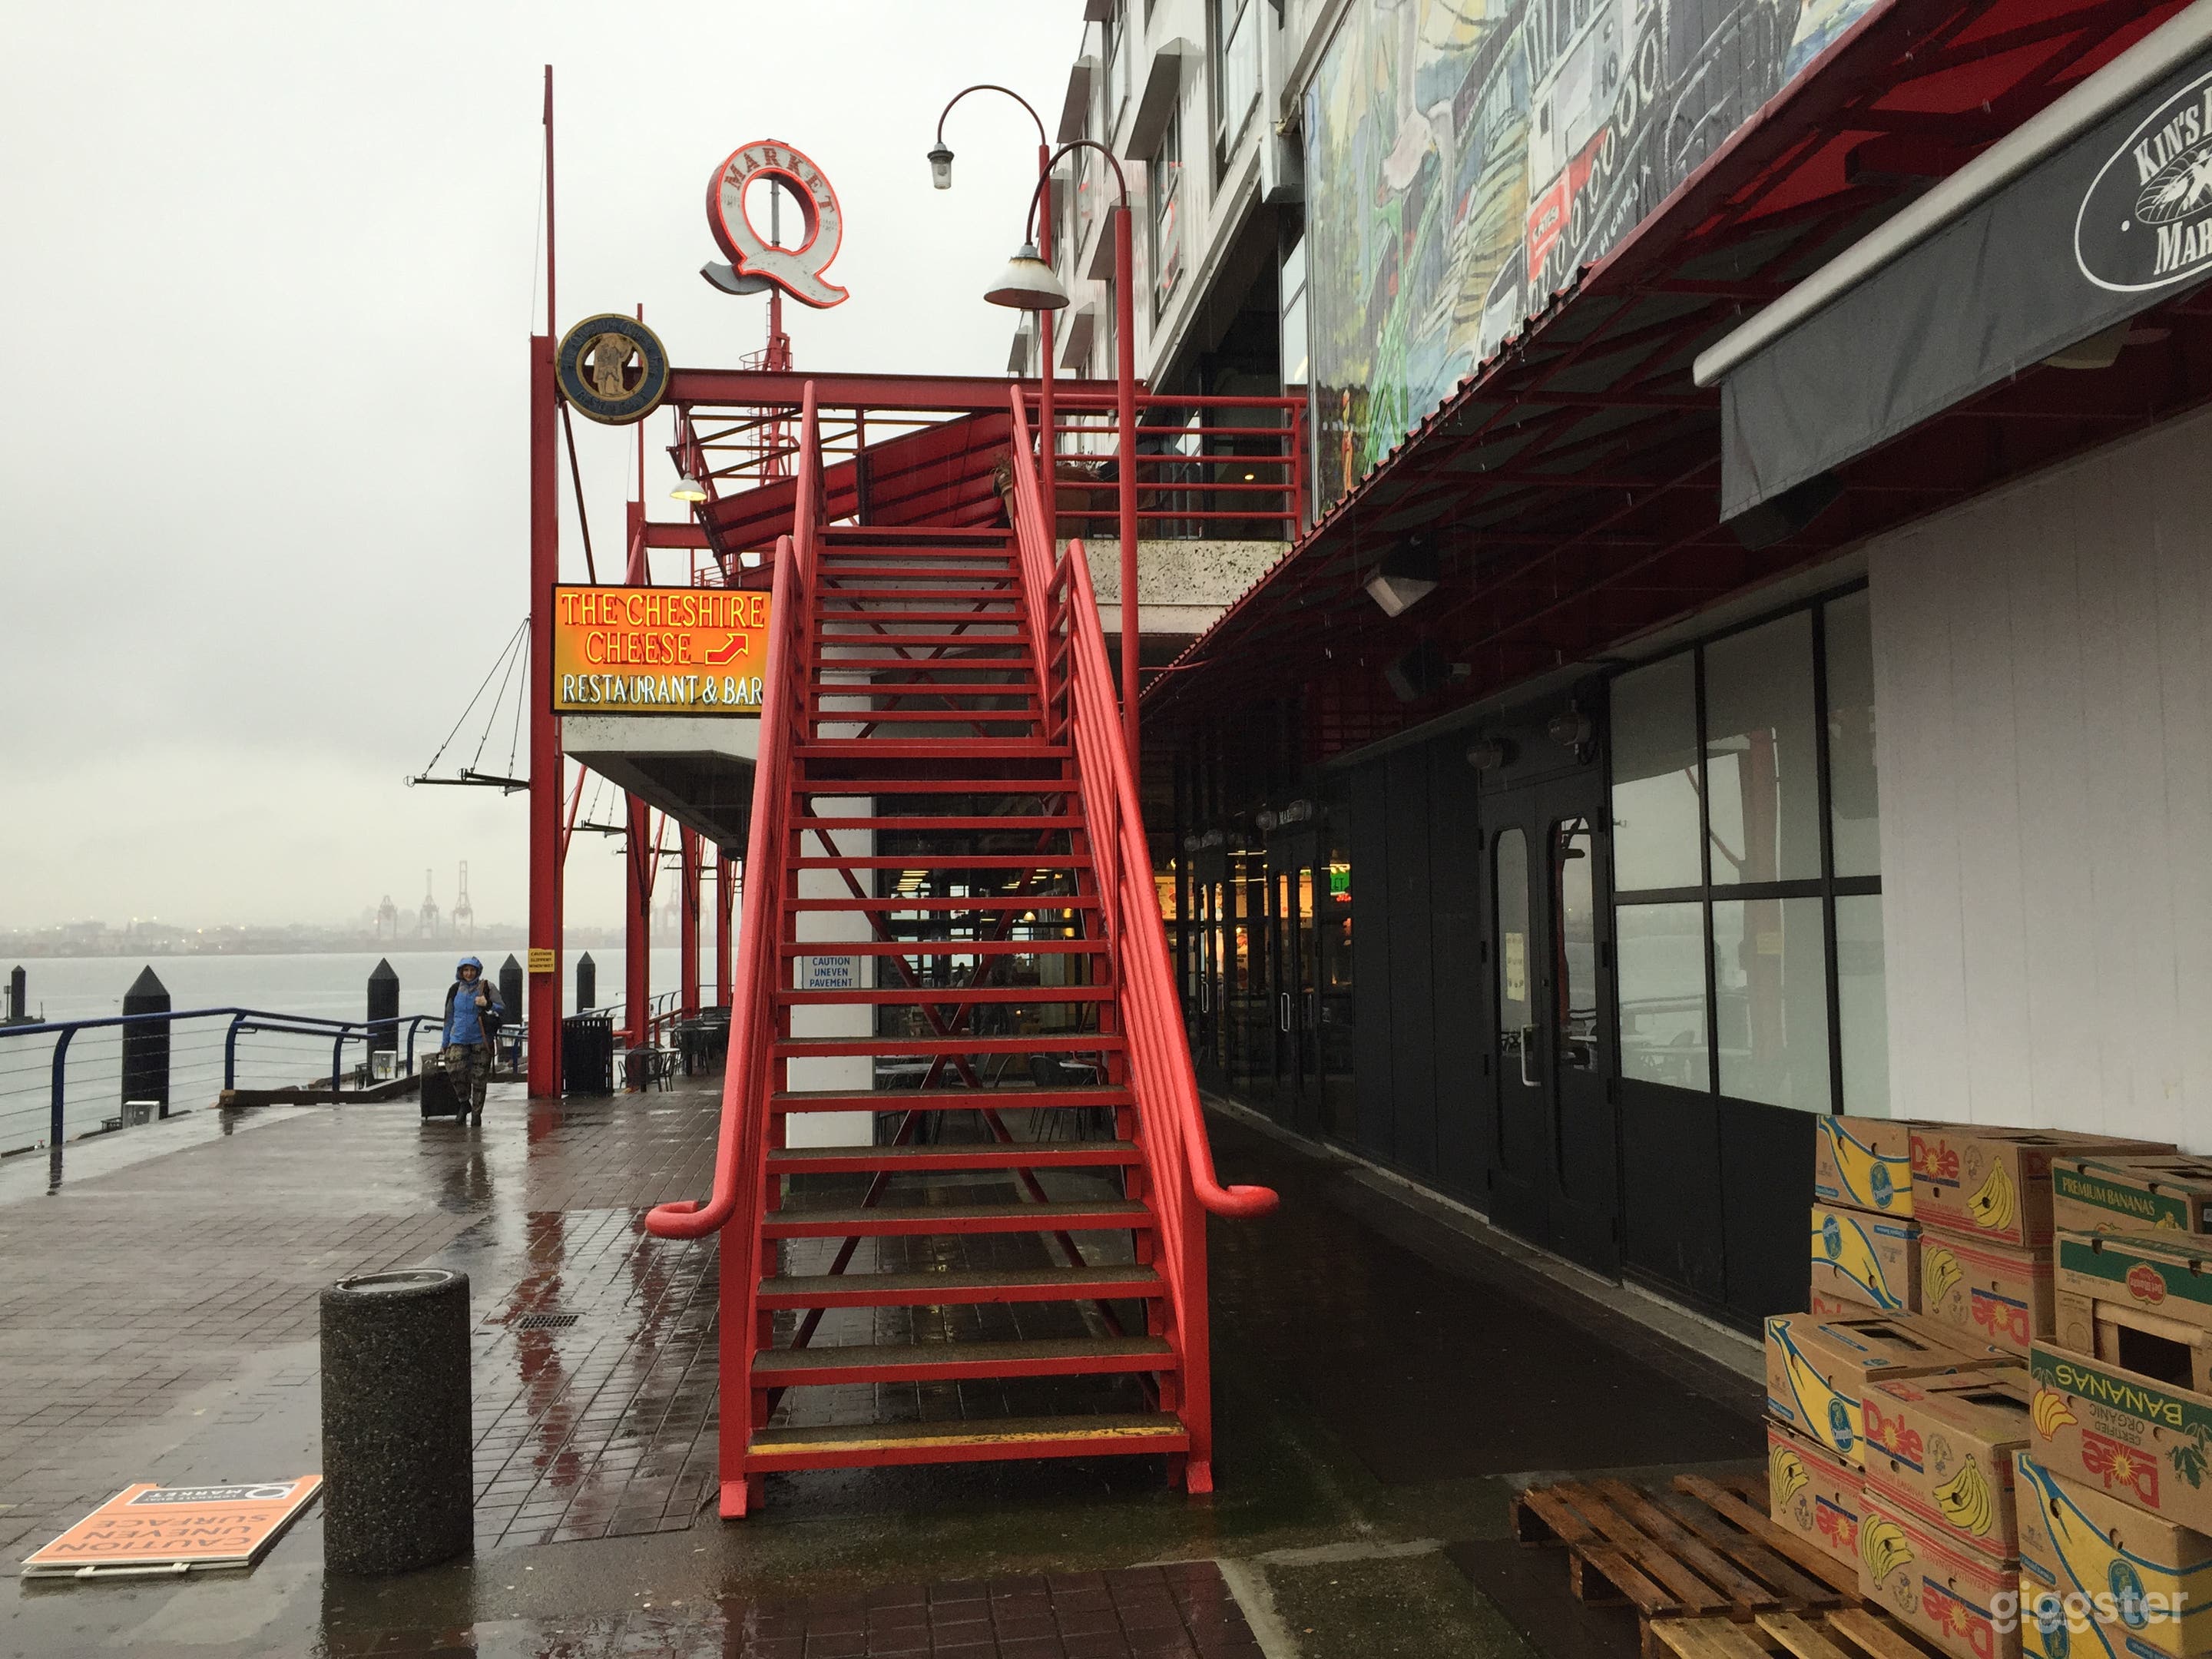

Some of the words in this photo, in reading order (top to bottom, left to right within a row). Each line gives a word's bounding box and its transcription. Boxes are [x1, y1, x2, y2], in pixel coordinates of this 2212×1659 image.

[2133, 104, 2200, 186] KIN'S
[724, 147, 835, 214] MARKET
[561, 593, 618, 626] THE
[626, 594, 765, 628] CHESHIRE
[585, 631, 691, 665] CHEESE
[561, 673, 699, 705] RESTAURANT
[702, 678, 719, 705] &
[721, 675, 763, 706] BAR
[813, 957, 850, 965] CAUTION
[814, 968, 848, 976] UNEVEN
[810, 979, 853, 987] PAVEMENT
[1910, 1136, 1960, 1179] Dole
[2063, 1177, 2105, 1202] PREMIUM
[2107, 1188, 2155, 1216] BANANAS
[1972, 1294, 2030, 1347] Dole
[2055, 1364, 2183, 1426] BANANAS
[1863, 1397, 1924, 1463] Dole
[2089, 1403, 2145, 1434] ORGANIC
[2094, 1421, 2141, 1446] CERTIFIED
[2081, 1440, 2160, 1509] Dole
[84, 1526, 252, 1541] UNEVEN
[95, 1515, 270, 1528] SURFACE
[55, 1537, 252, 1553] CAUTION
[1922, 1586, 1995, 1659] Dole
